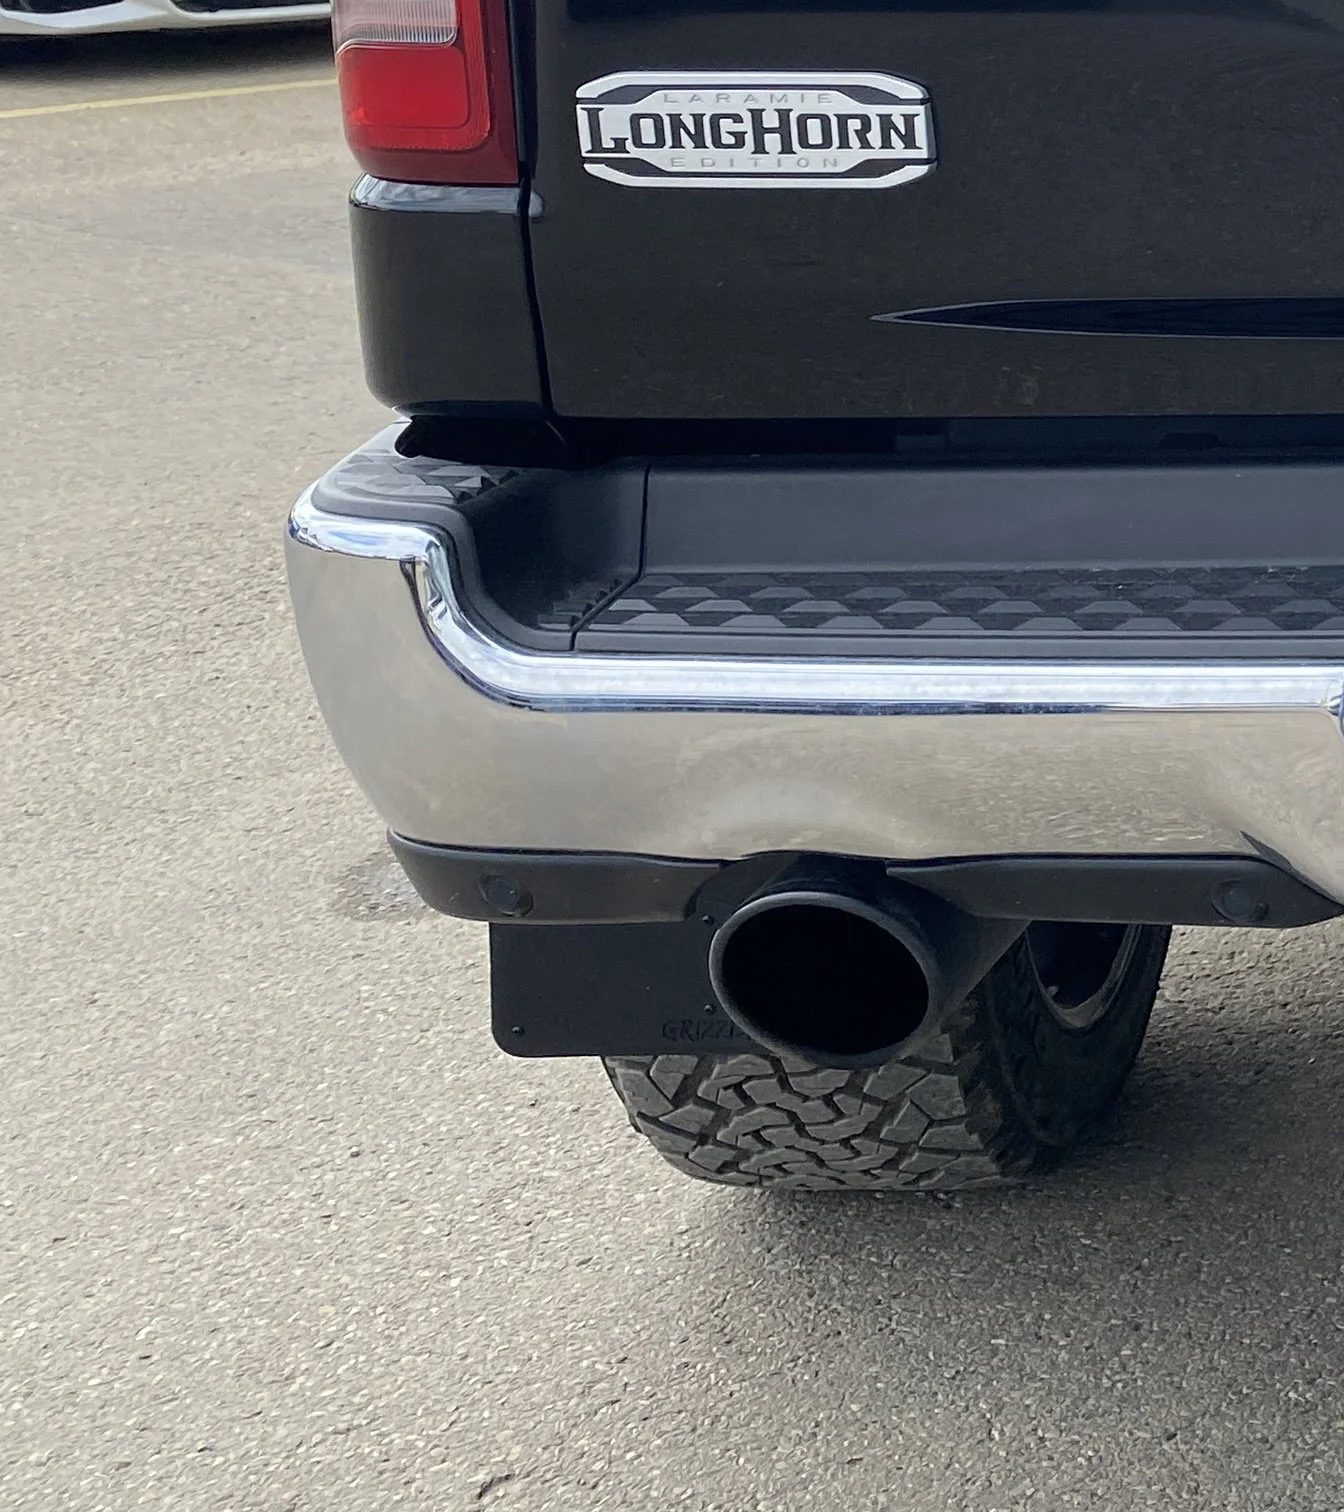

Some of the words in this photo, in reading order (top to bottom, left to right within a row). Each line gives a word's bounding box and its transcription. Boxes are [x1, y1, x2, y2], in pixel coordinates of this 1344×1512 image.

[663, 92, 833, 104] LARAMIE
[670, 156, 840, 169] EDITION
[661, 1017, 751, 1042] GRIZZL
